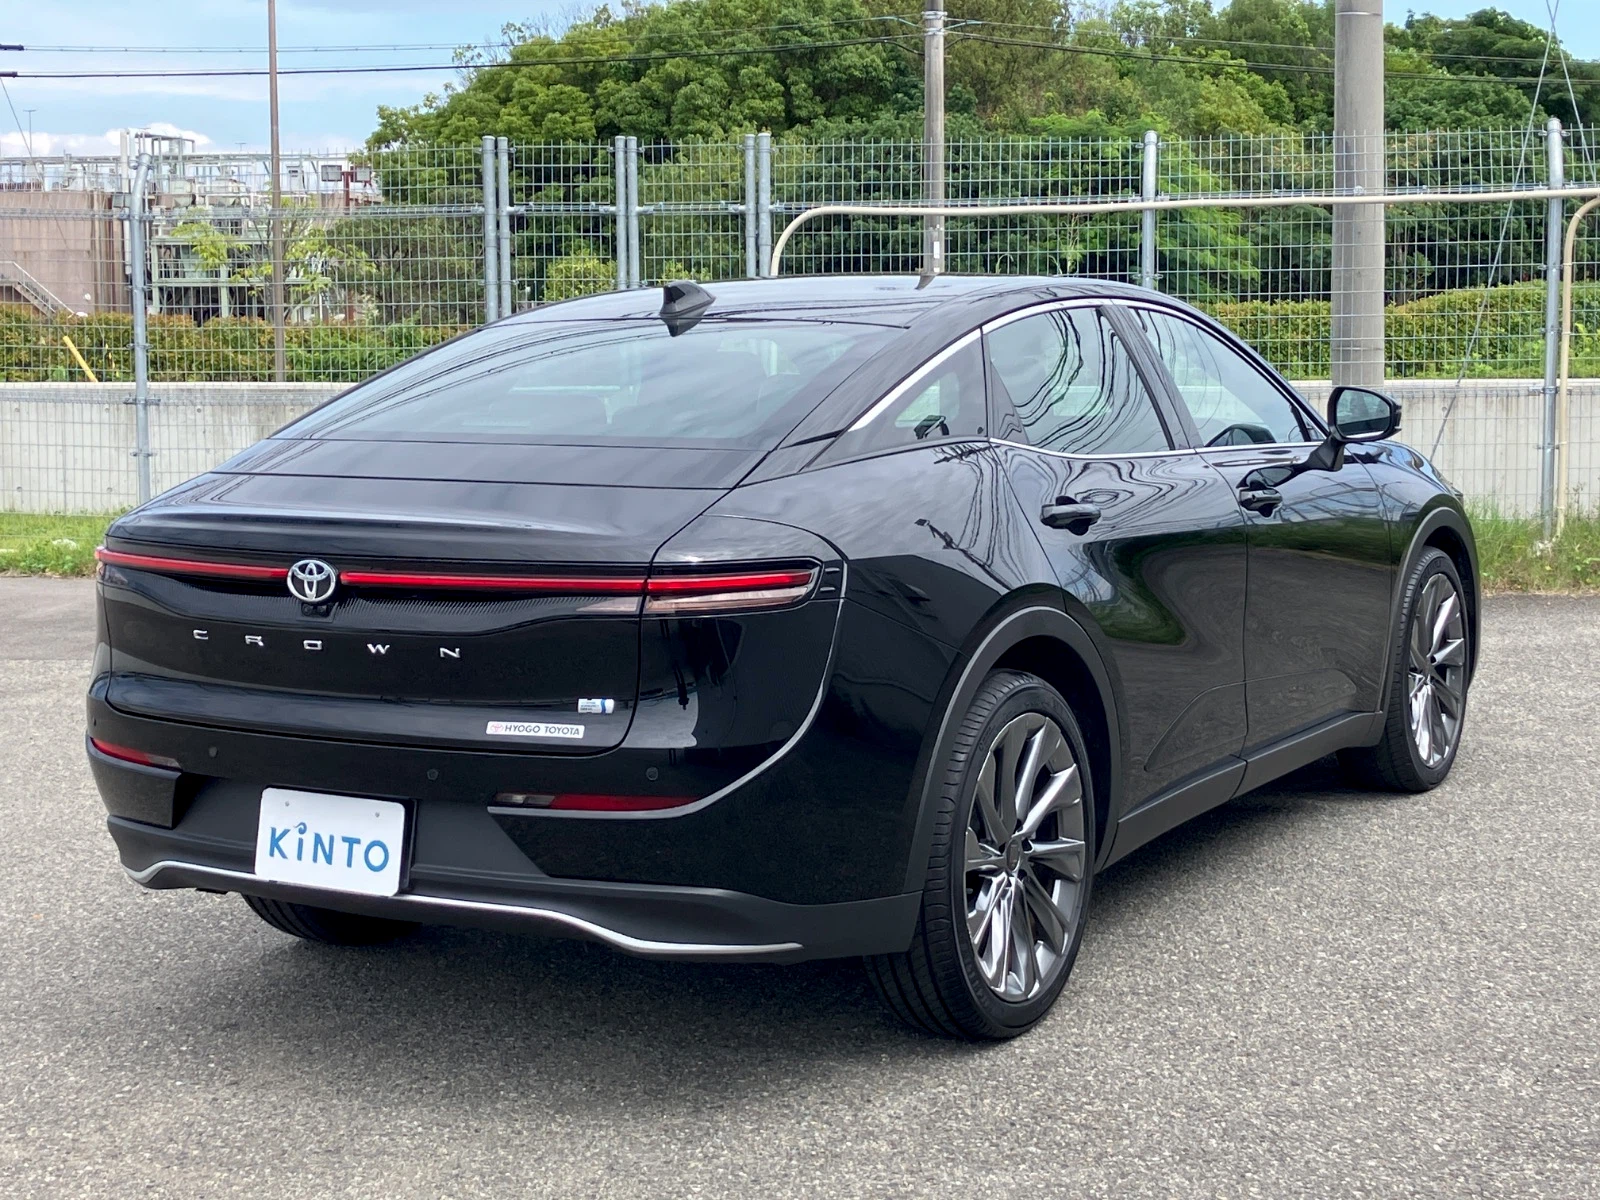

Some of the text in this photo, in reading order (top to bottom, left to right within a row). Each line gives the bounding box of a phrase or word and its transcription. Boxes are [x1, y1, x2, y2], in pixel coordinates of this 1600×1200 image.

[193, 629, 461, 659] CROWN
[504, 724, 580, 736] HYOGO TOYOTA
